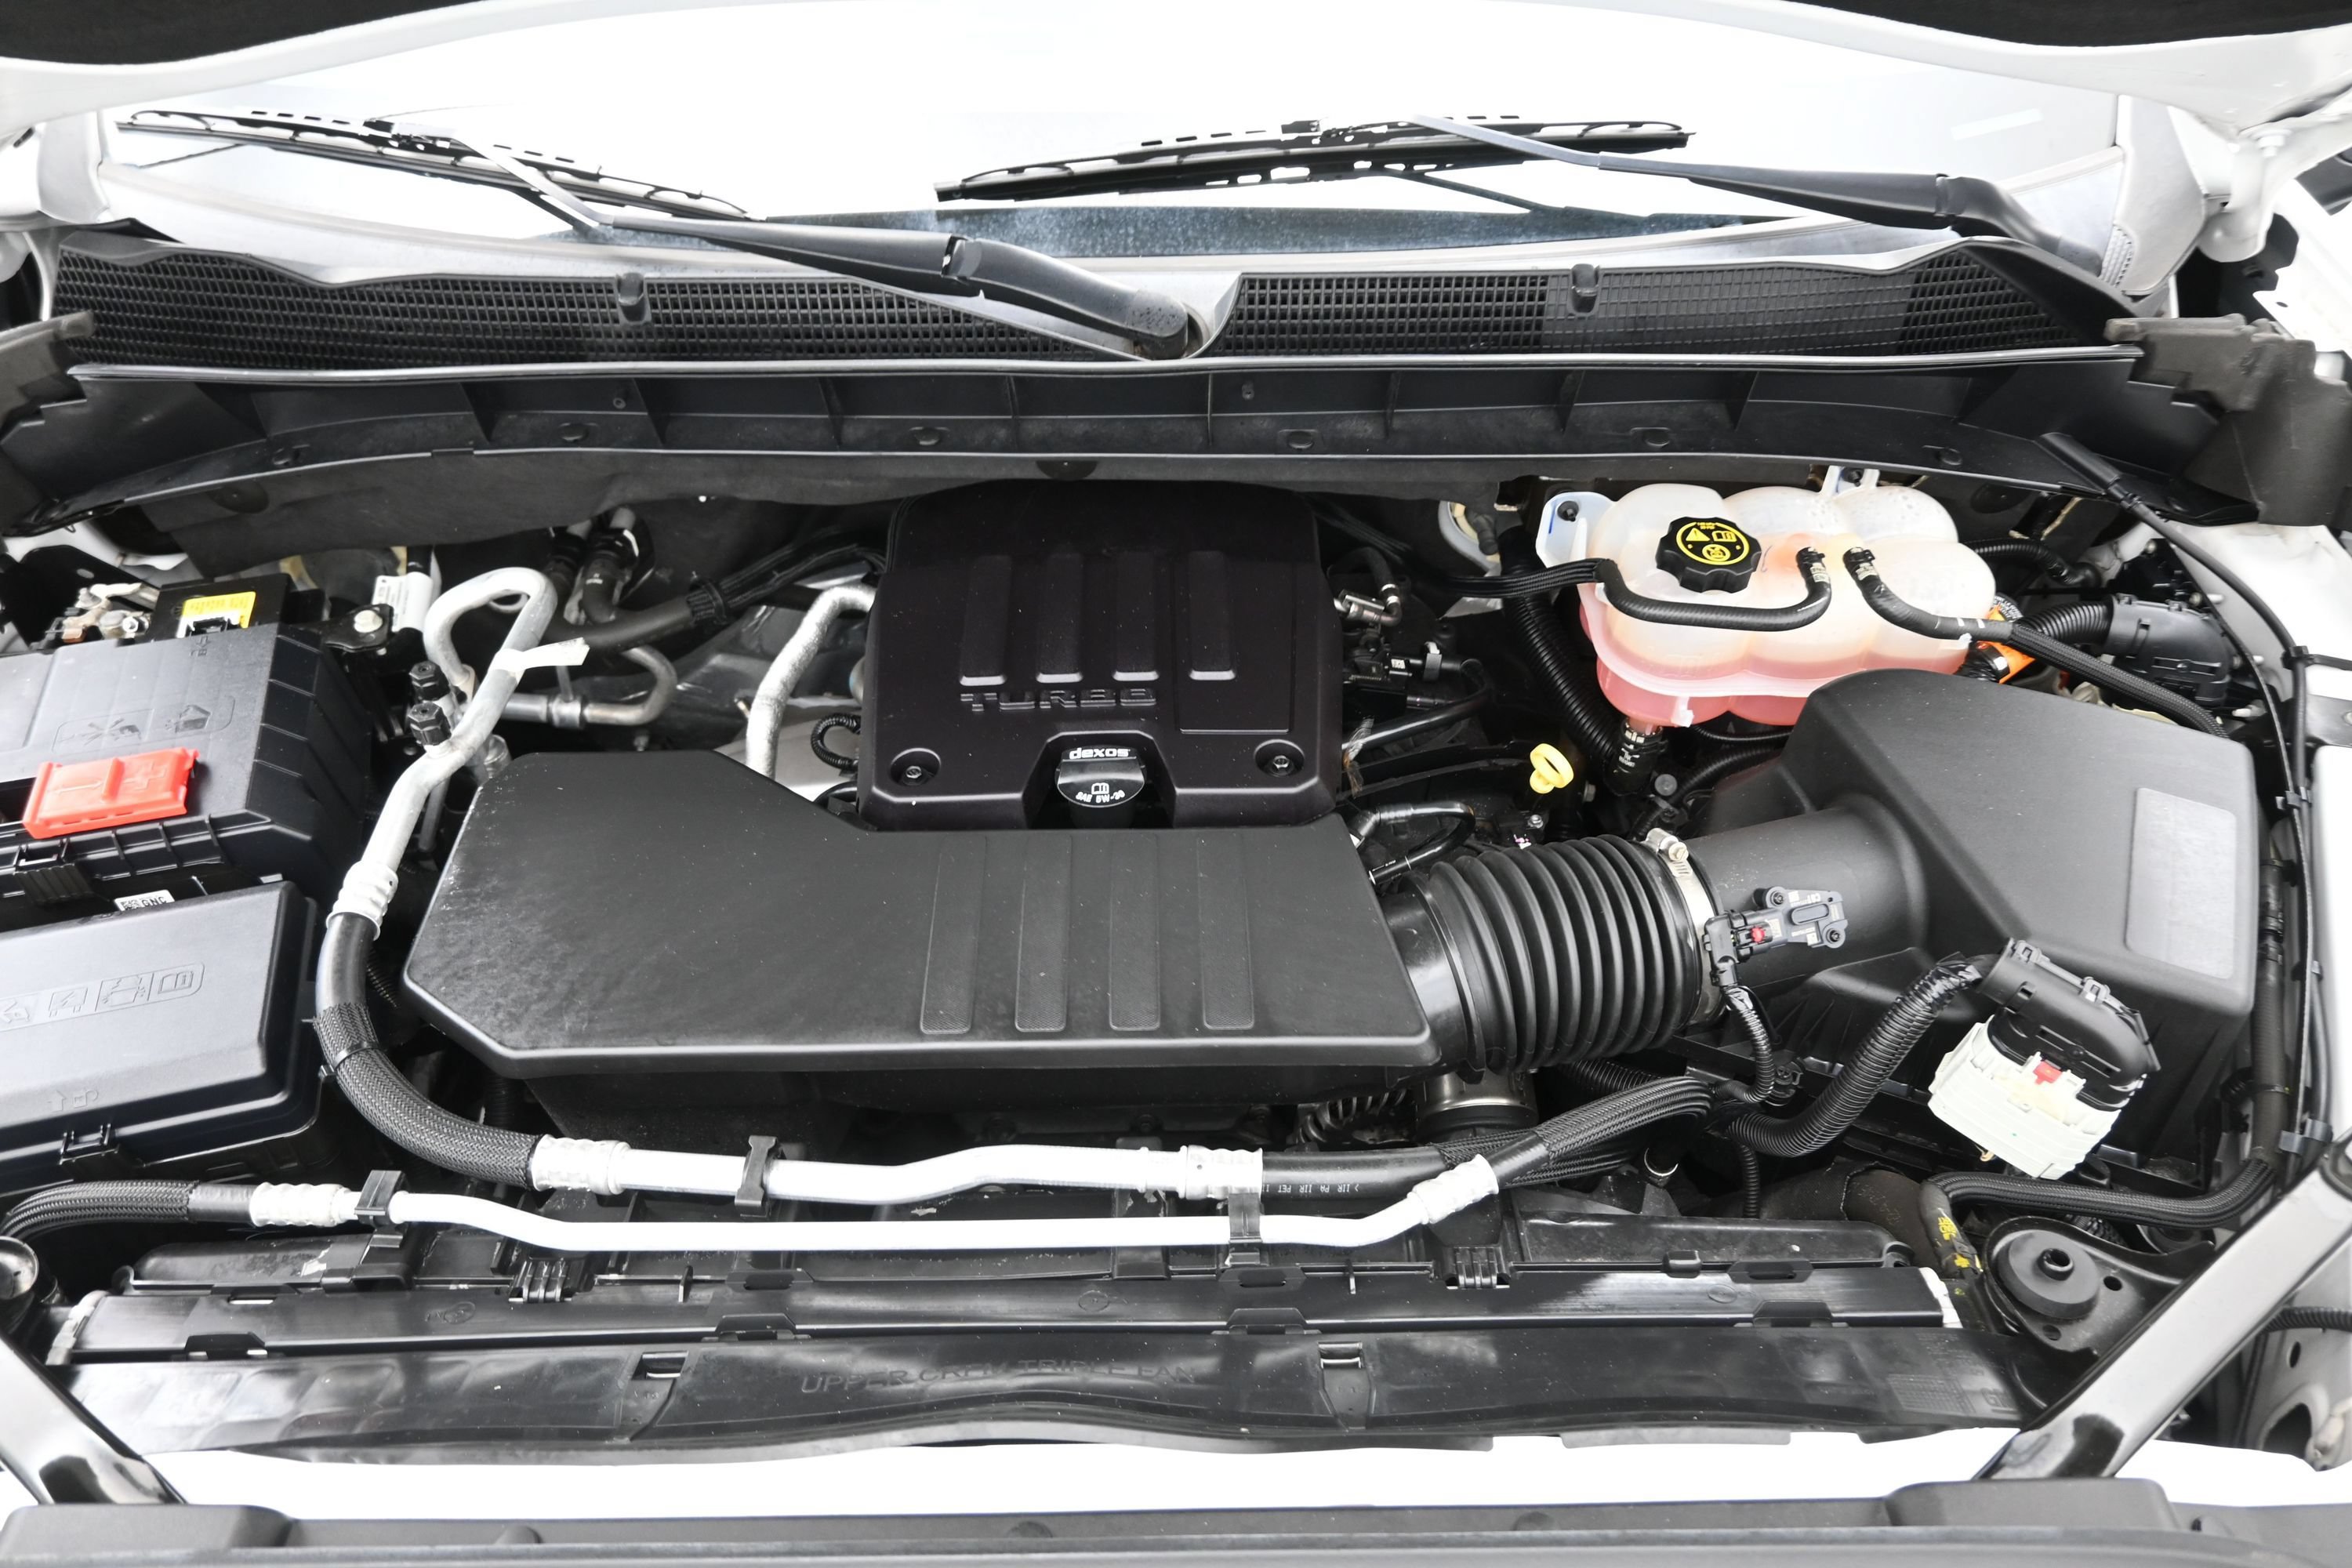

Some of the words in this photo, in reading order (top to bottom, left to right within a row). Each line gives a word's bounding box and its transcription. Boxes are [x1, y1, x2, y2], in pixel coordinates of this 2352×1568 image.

[960, 688, 1156, 712] TURBO
[1069, 747, 1130, 760] dexos
[1278, 1184, 1292, 1193] PET
[800, 1370, 915, 1394] UPPER
[1018, 1359, 1127, 1375] TRIPLE
[1137, 1366, 1196, 1384] FAN
